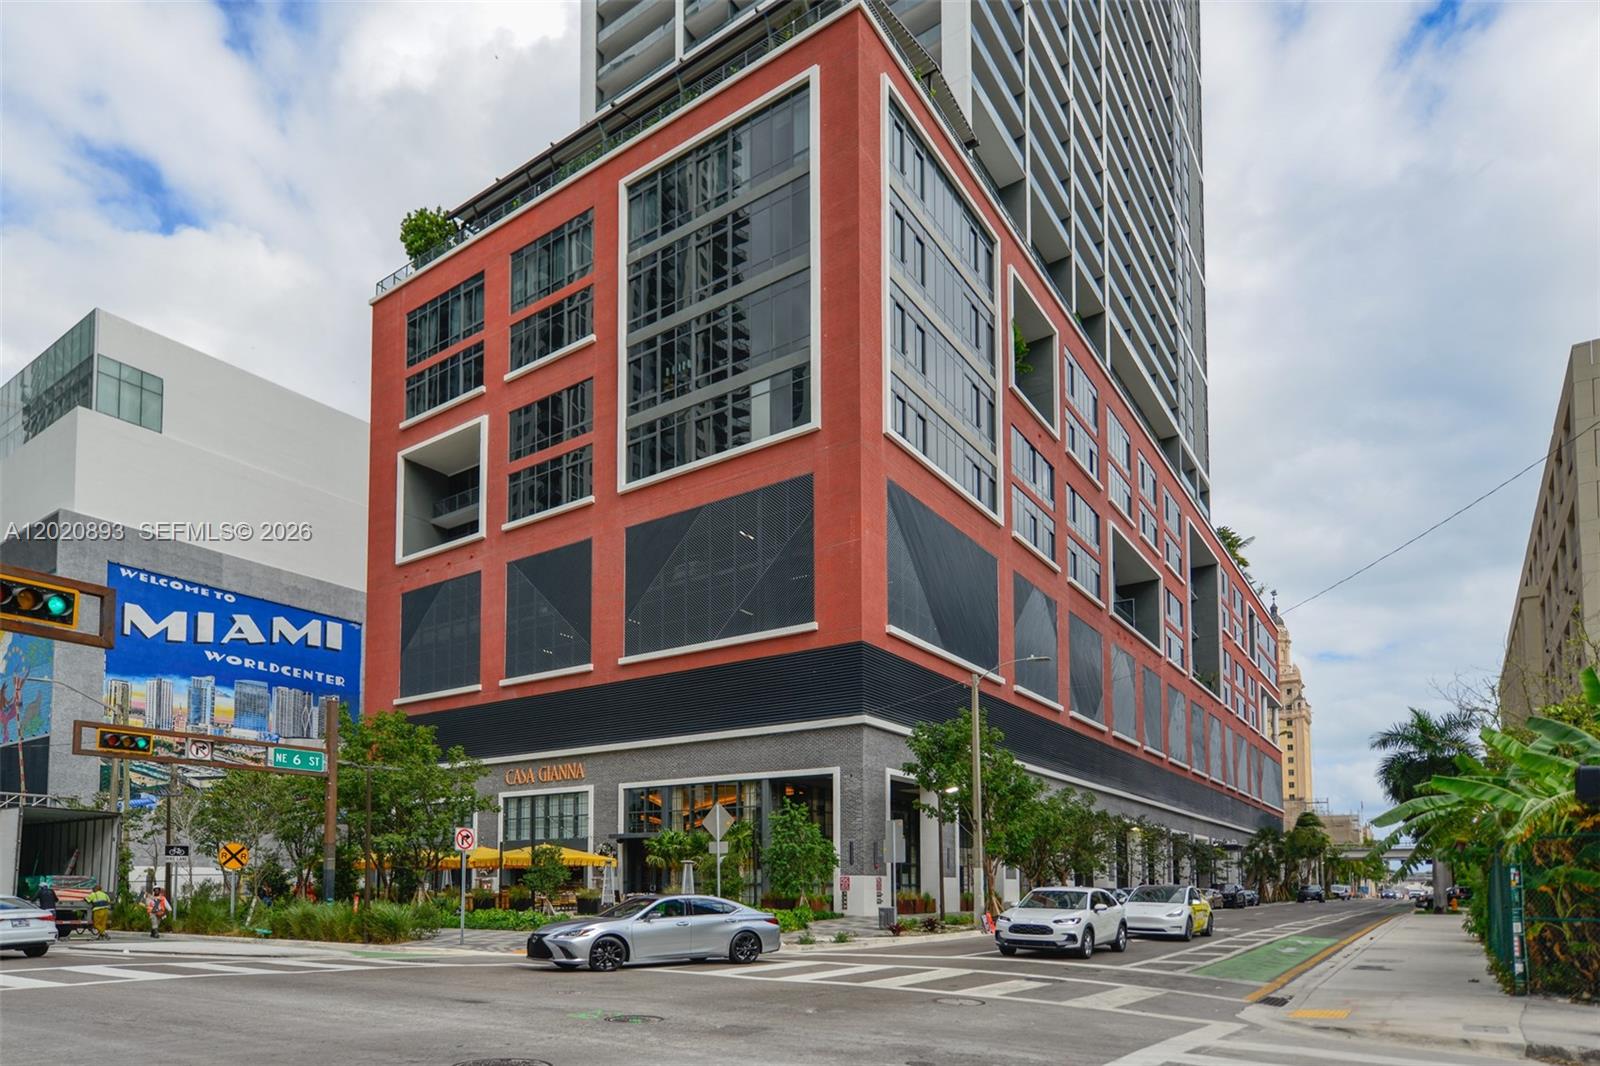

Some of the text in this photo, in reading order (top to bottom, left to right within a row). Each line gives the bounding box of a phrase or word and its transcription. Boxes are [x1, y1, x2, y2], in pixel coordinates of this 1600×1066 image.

[119, 567, 237, 604] WELCOME TO
[121, 602, 344, 651] MIAMI
[203, 651, 346, 688] WORLDCENTER
[275, 752, 320, 767] NE 6 ST
[504, 762, 585, 786] CASA GIANNA
